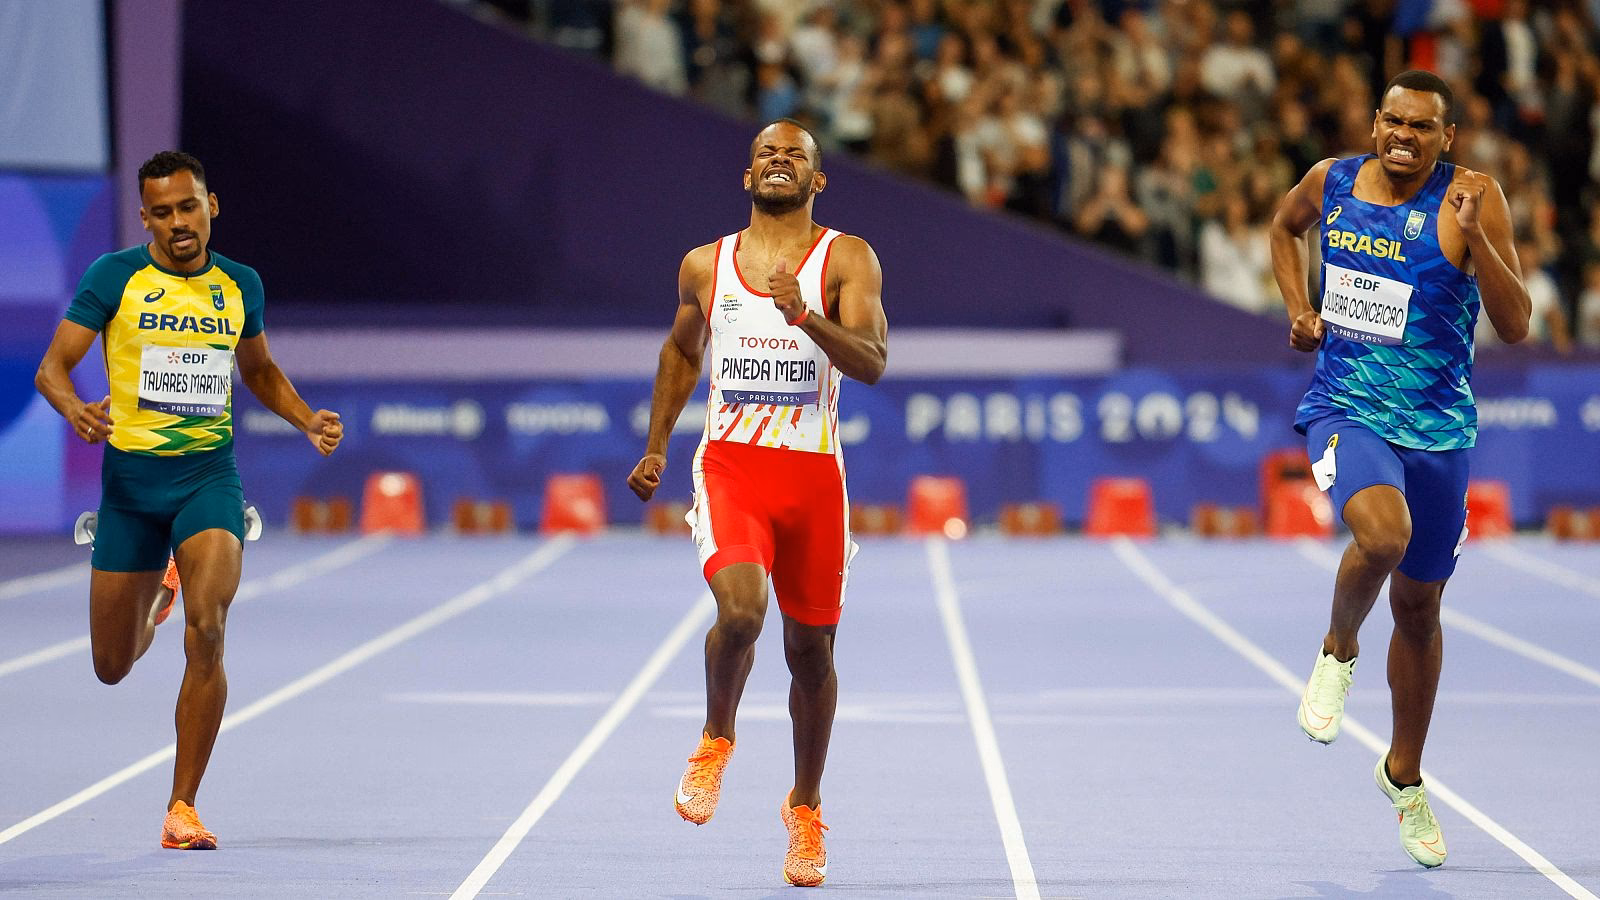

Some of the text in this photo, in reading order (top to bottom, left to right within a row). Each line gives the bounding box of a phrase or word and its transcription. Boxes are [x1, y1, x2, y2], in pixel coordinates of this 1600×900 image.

[1327, 229, 1406, 262] BRASIL
[1353, 277, 1381, 292] eDF
[138, 312, 237, 336] BRASIL
[1348, 298, 1404, 328] CONCEICAO
[739, 337, 799, 350] TOYOTA
[1339, 328, 1382, 343] PARIS 2024
[182, 353, 208, 364] eDF
[721, 358, 816, 382] PINEDA MEJIA
[143, 371, 188, 393] TAVARES
[171, 405, 194, 413] PARIS
[905, 391, 1259, 443] PARIS 2024
